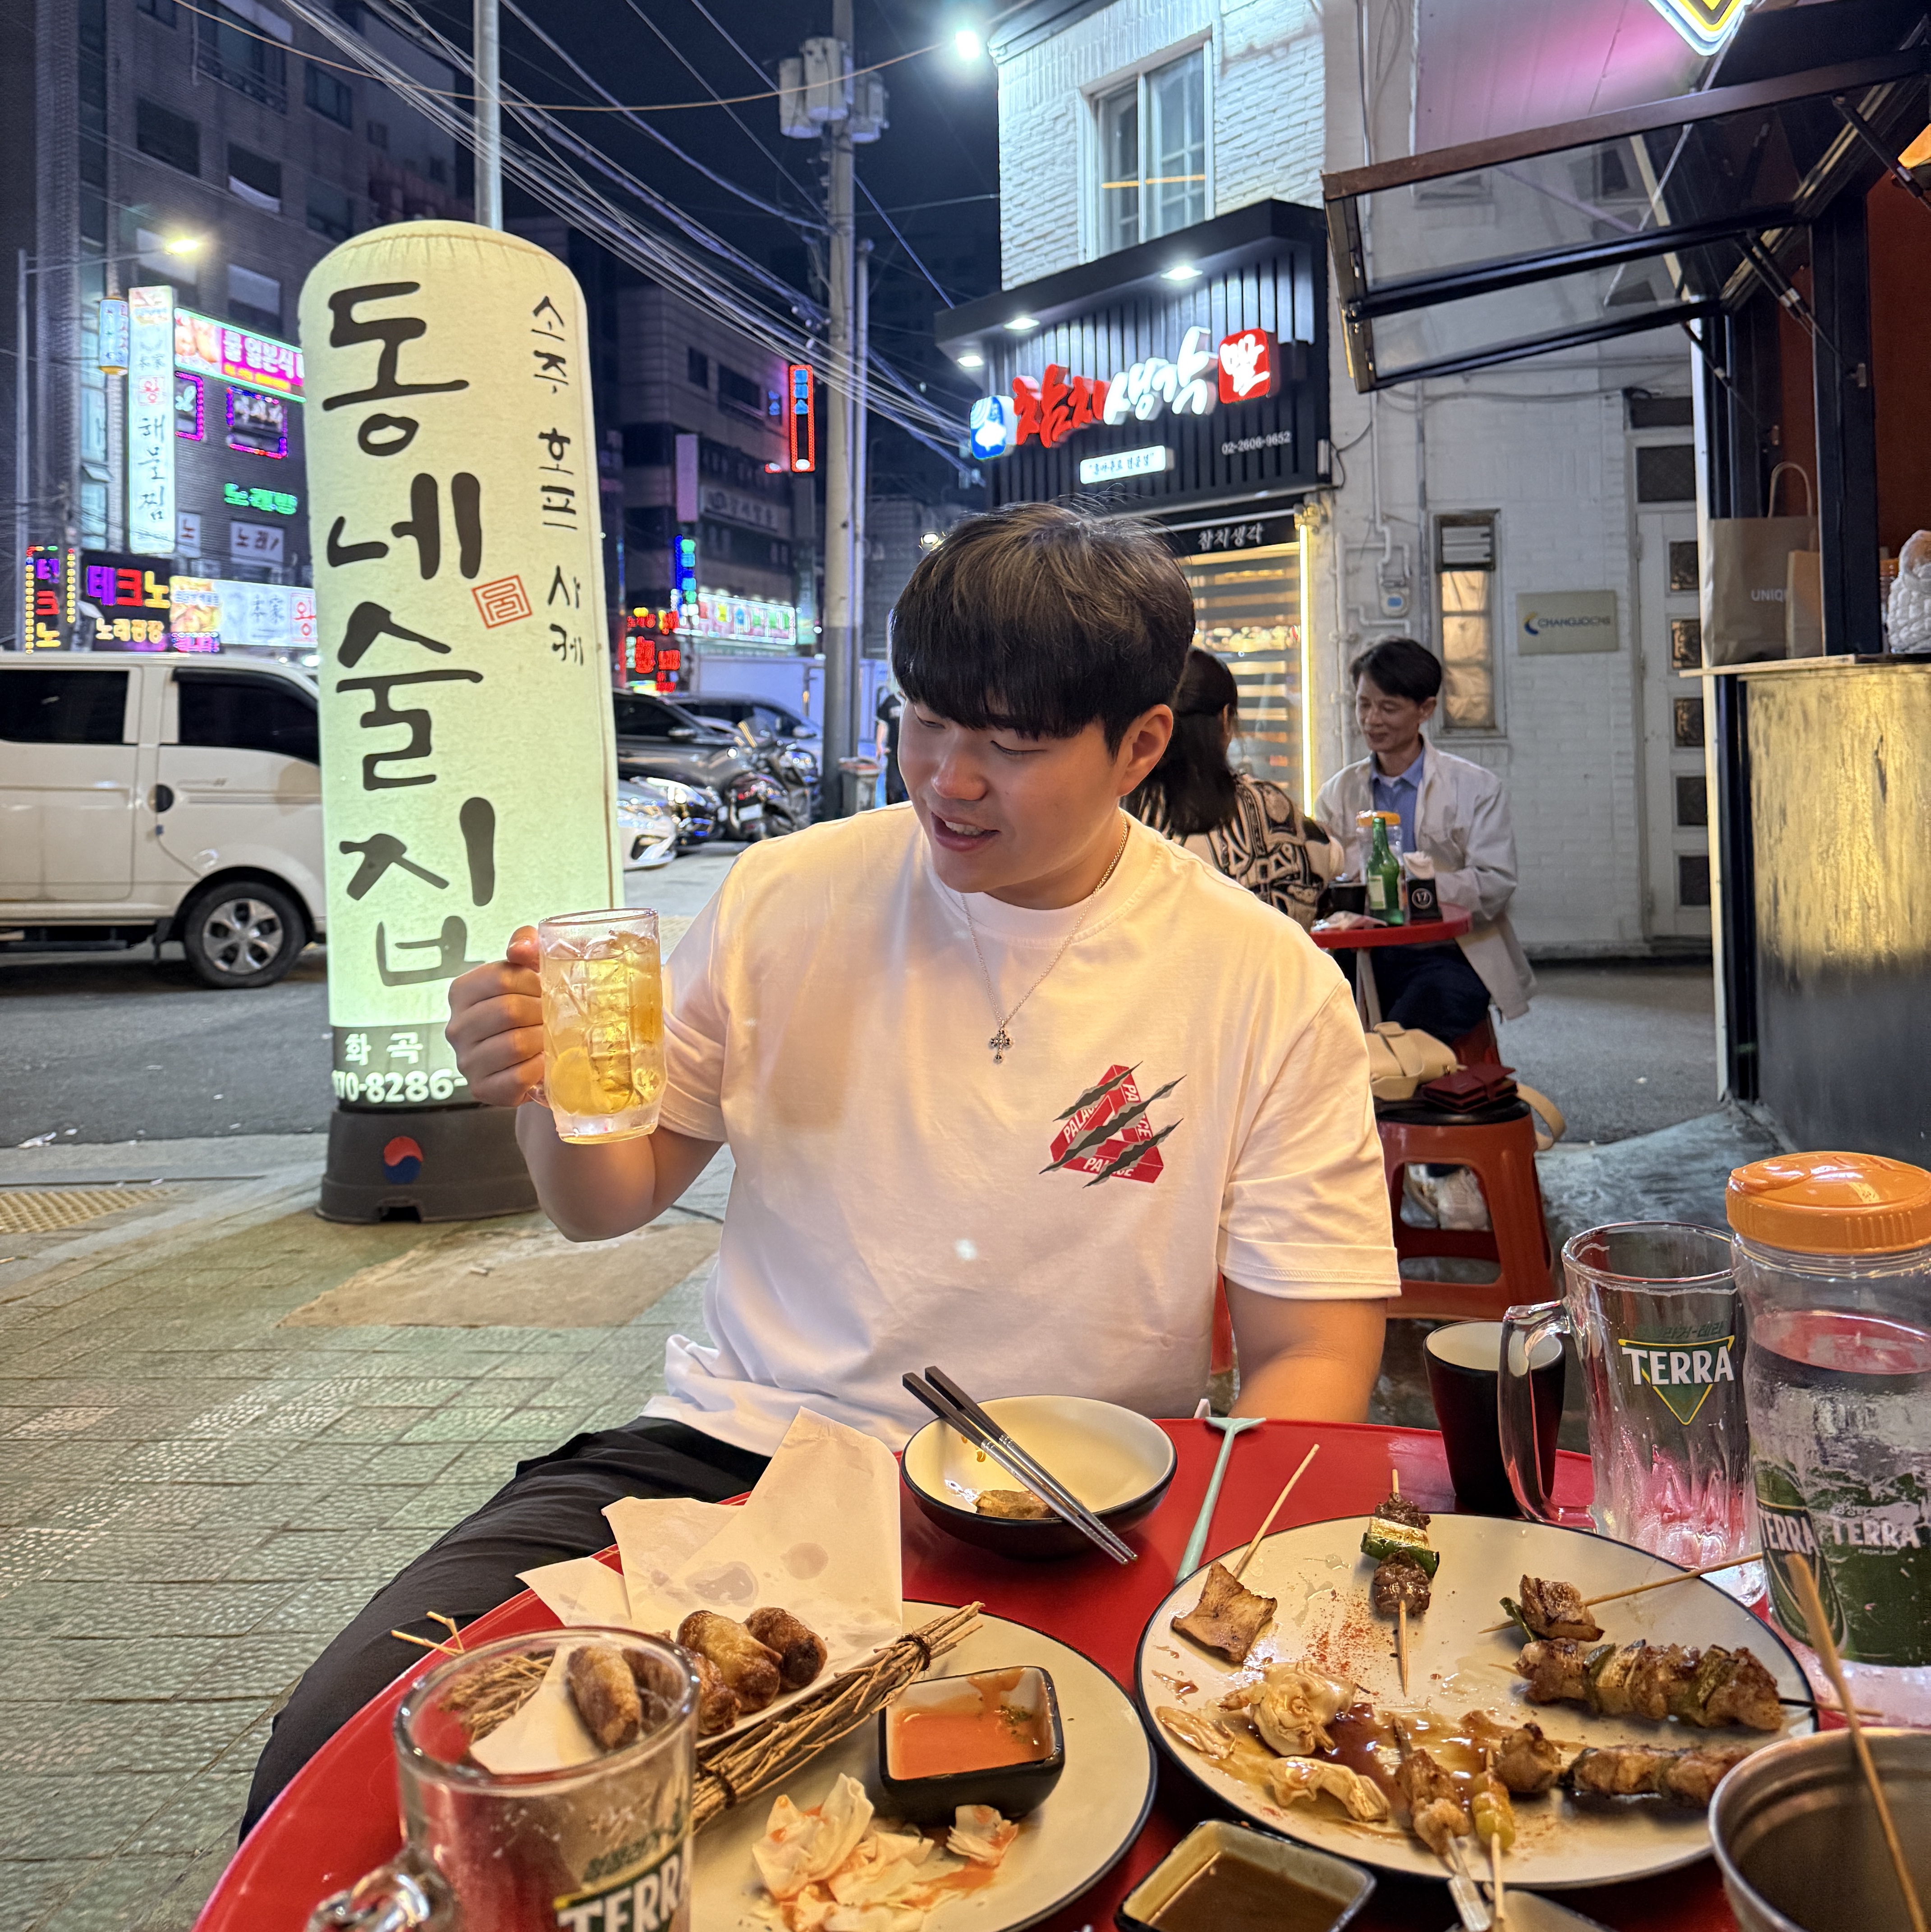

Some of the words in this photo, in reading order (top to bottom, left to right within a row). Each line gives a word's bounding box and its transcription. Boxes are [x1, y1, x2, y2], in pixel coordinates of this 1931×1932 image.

[531, 296, 569, 394] 소주
[538, 427, 578, 530] 호프
[1198, 523, 1264, 551] 참치생각
[87, 565, 170, 609] 테크노
[322, 281, 496, 987] 동네술집
[546, 565, 584, 666] 사케
[1622, 1346, 1734, 1385] TERRA
[1758, 1507, 1821, 1556] TERRA
[1832, 1519, 1921, 1550] TERRA
